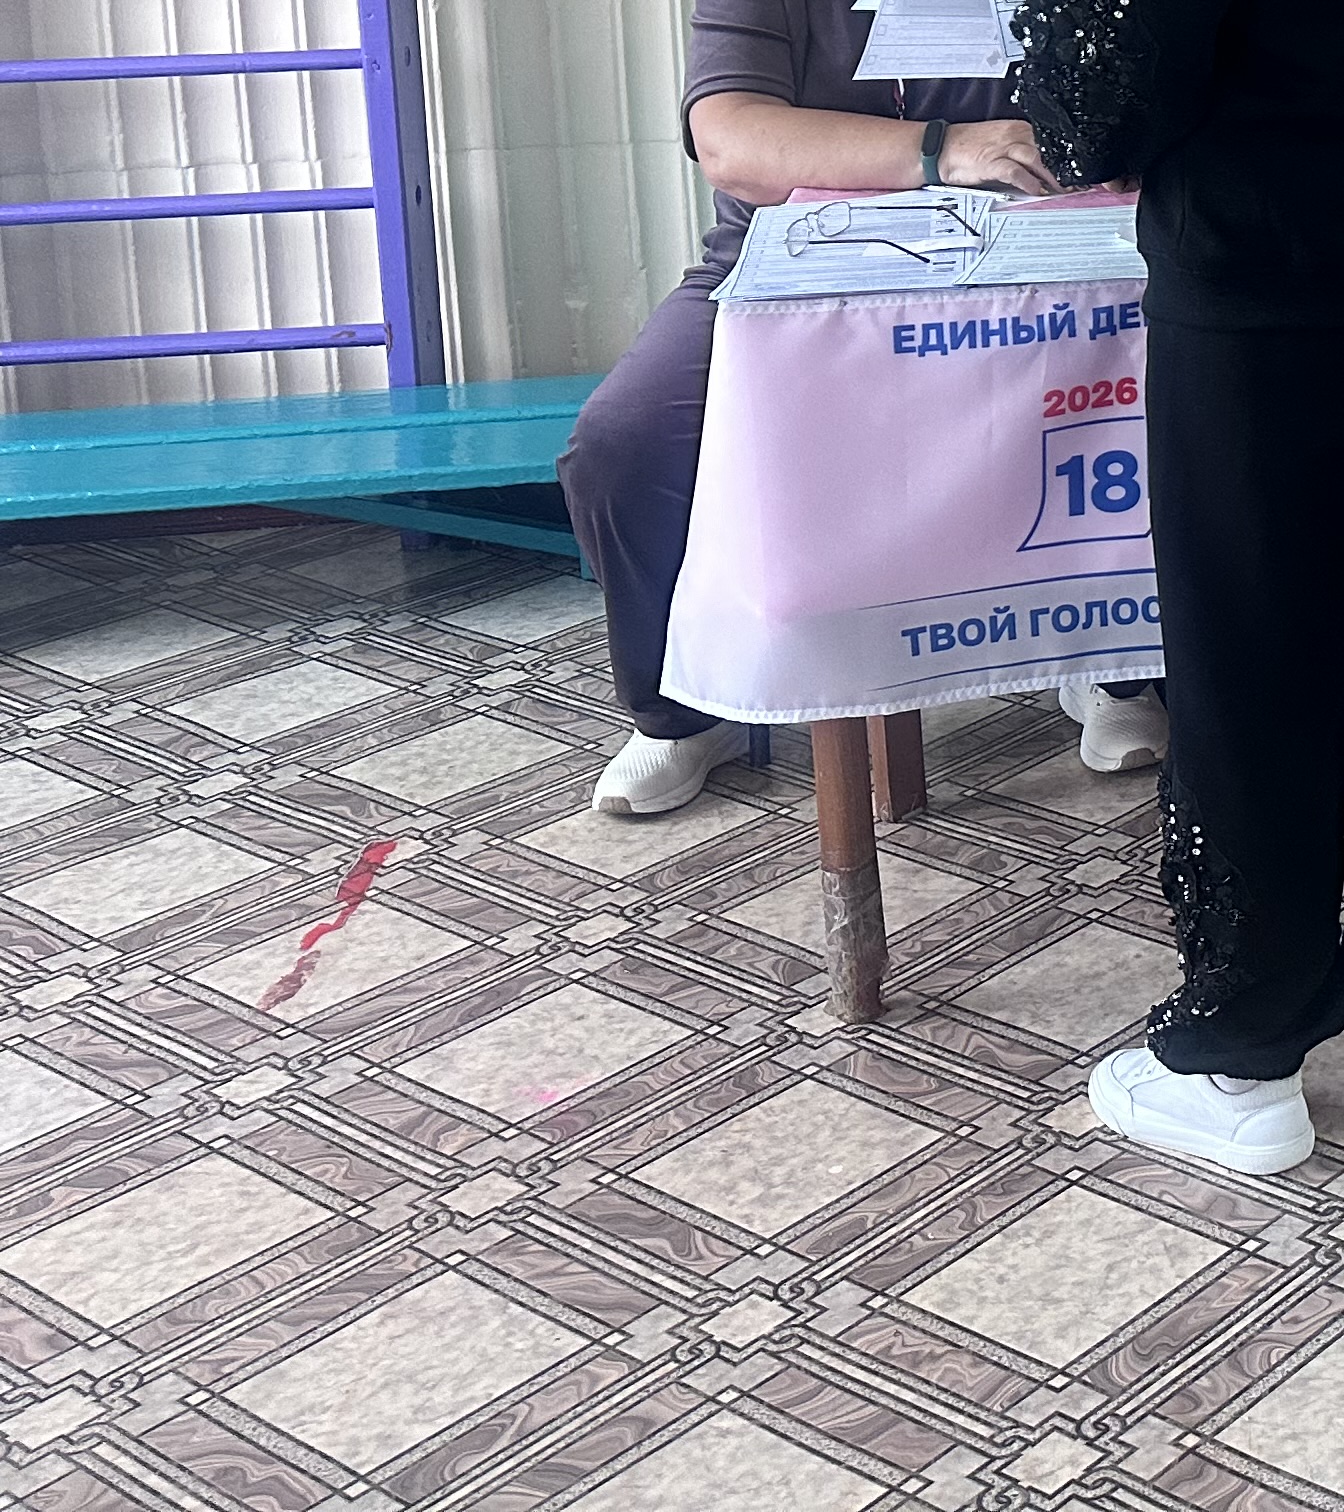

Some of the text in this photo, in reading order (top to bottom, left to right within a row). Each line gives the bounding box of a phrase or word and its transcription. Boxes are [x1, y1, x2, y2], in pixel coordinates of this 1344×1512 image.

[892, 300, 1151, 358] ЕДИНЫЙ ДЕ
[1043, 376, 1139, 419] 2026
[1054, 449, 1142, 518] 18
[900, 595, 1161, 658] ТВОЙ ГОЛОС
